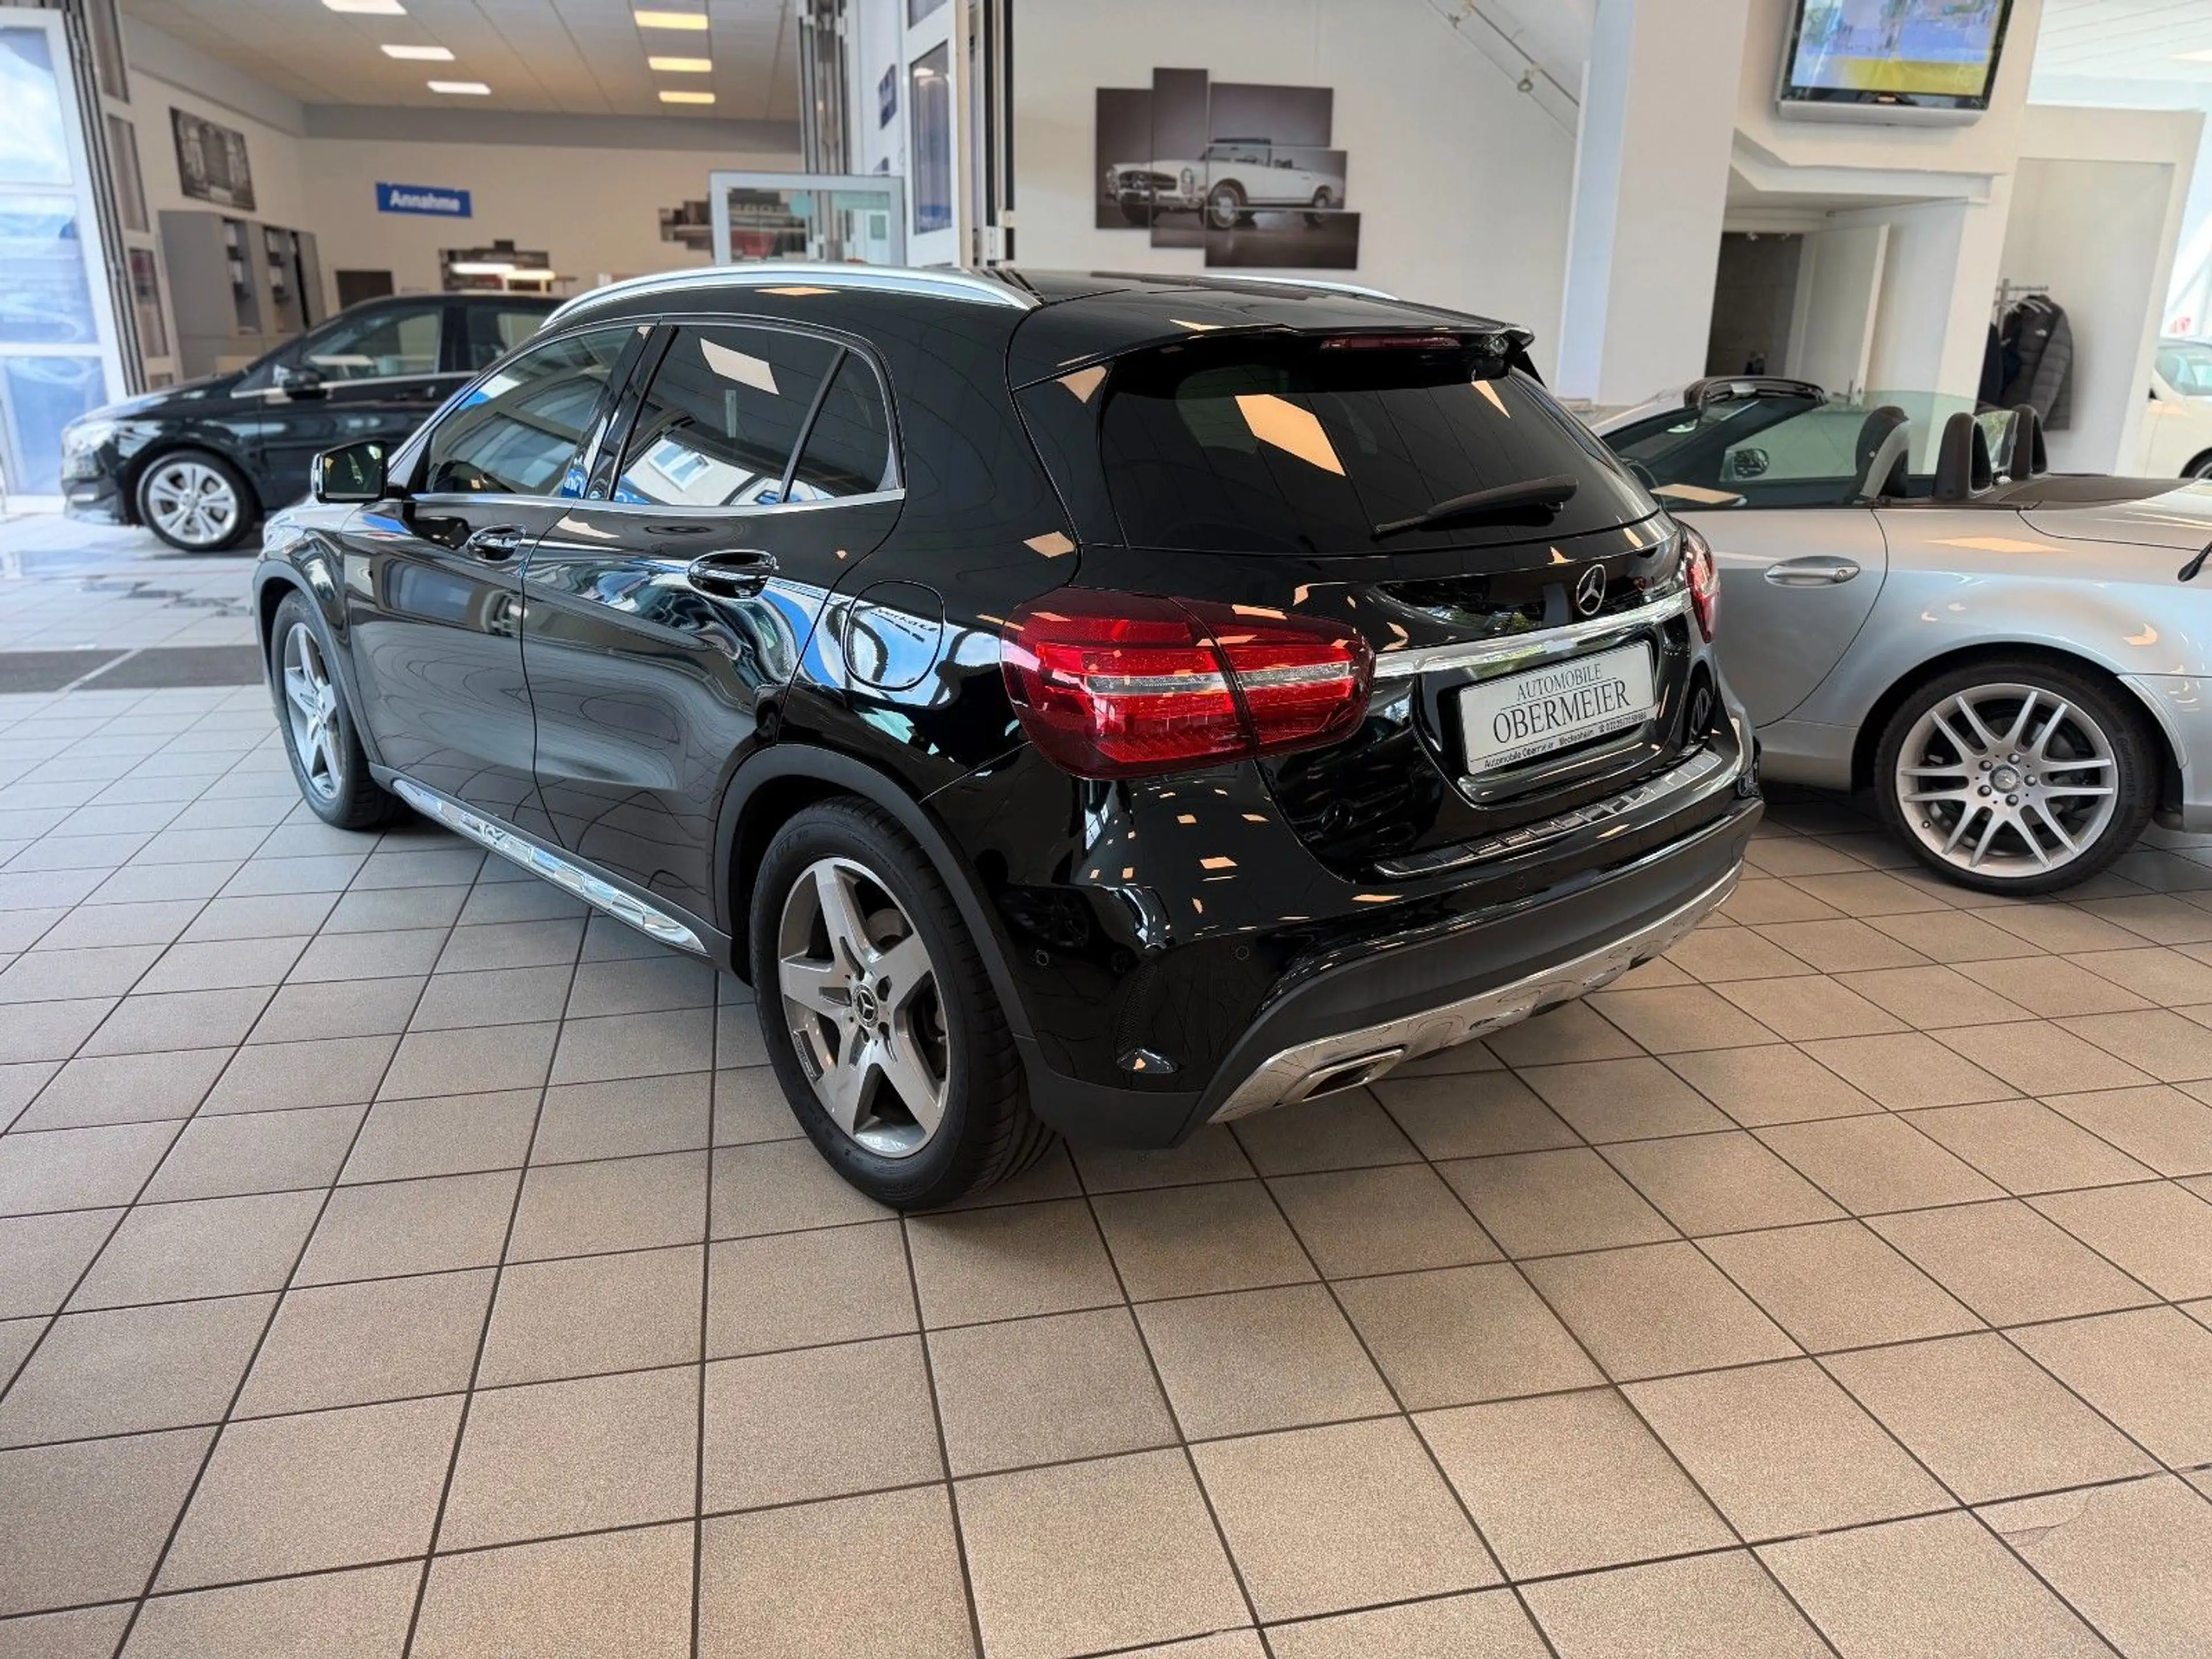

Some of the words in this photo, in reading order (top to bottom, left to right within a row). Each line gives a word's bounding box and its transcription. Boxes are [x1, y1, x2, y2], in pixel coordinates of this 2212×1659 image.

[389, 189, 461, 213] Annahme
[1517, 663, 1601, 701] AUTOMOBILE
[1493, 680, 1631, 743] OBERMEIER
